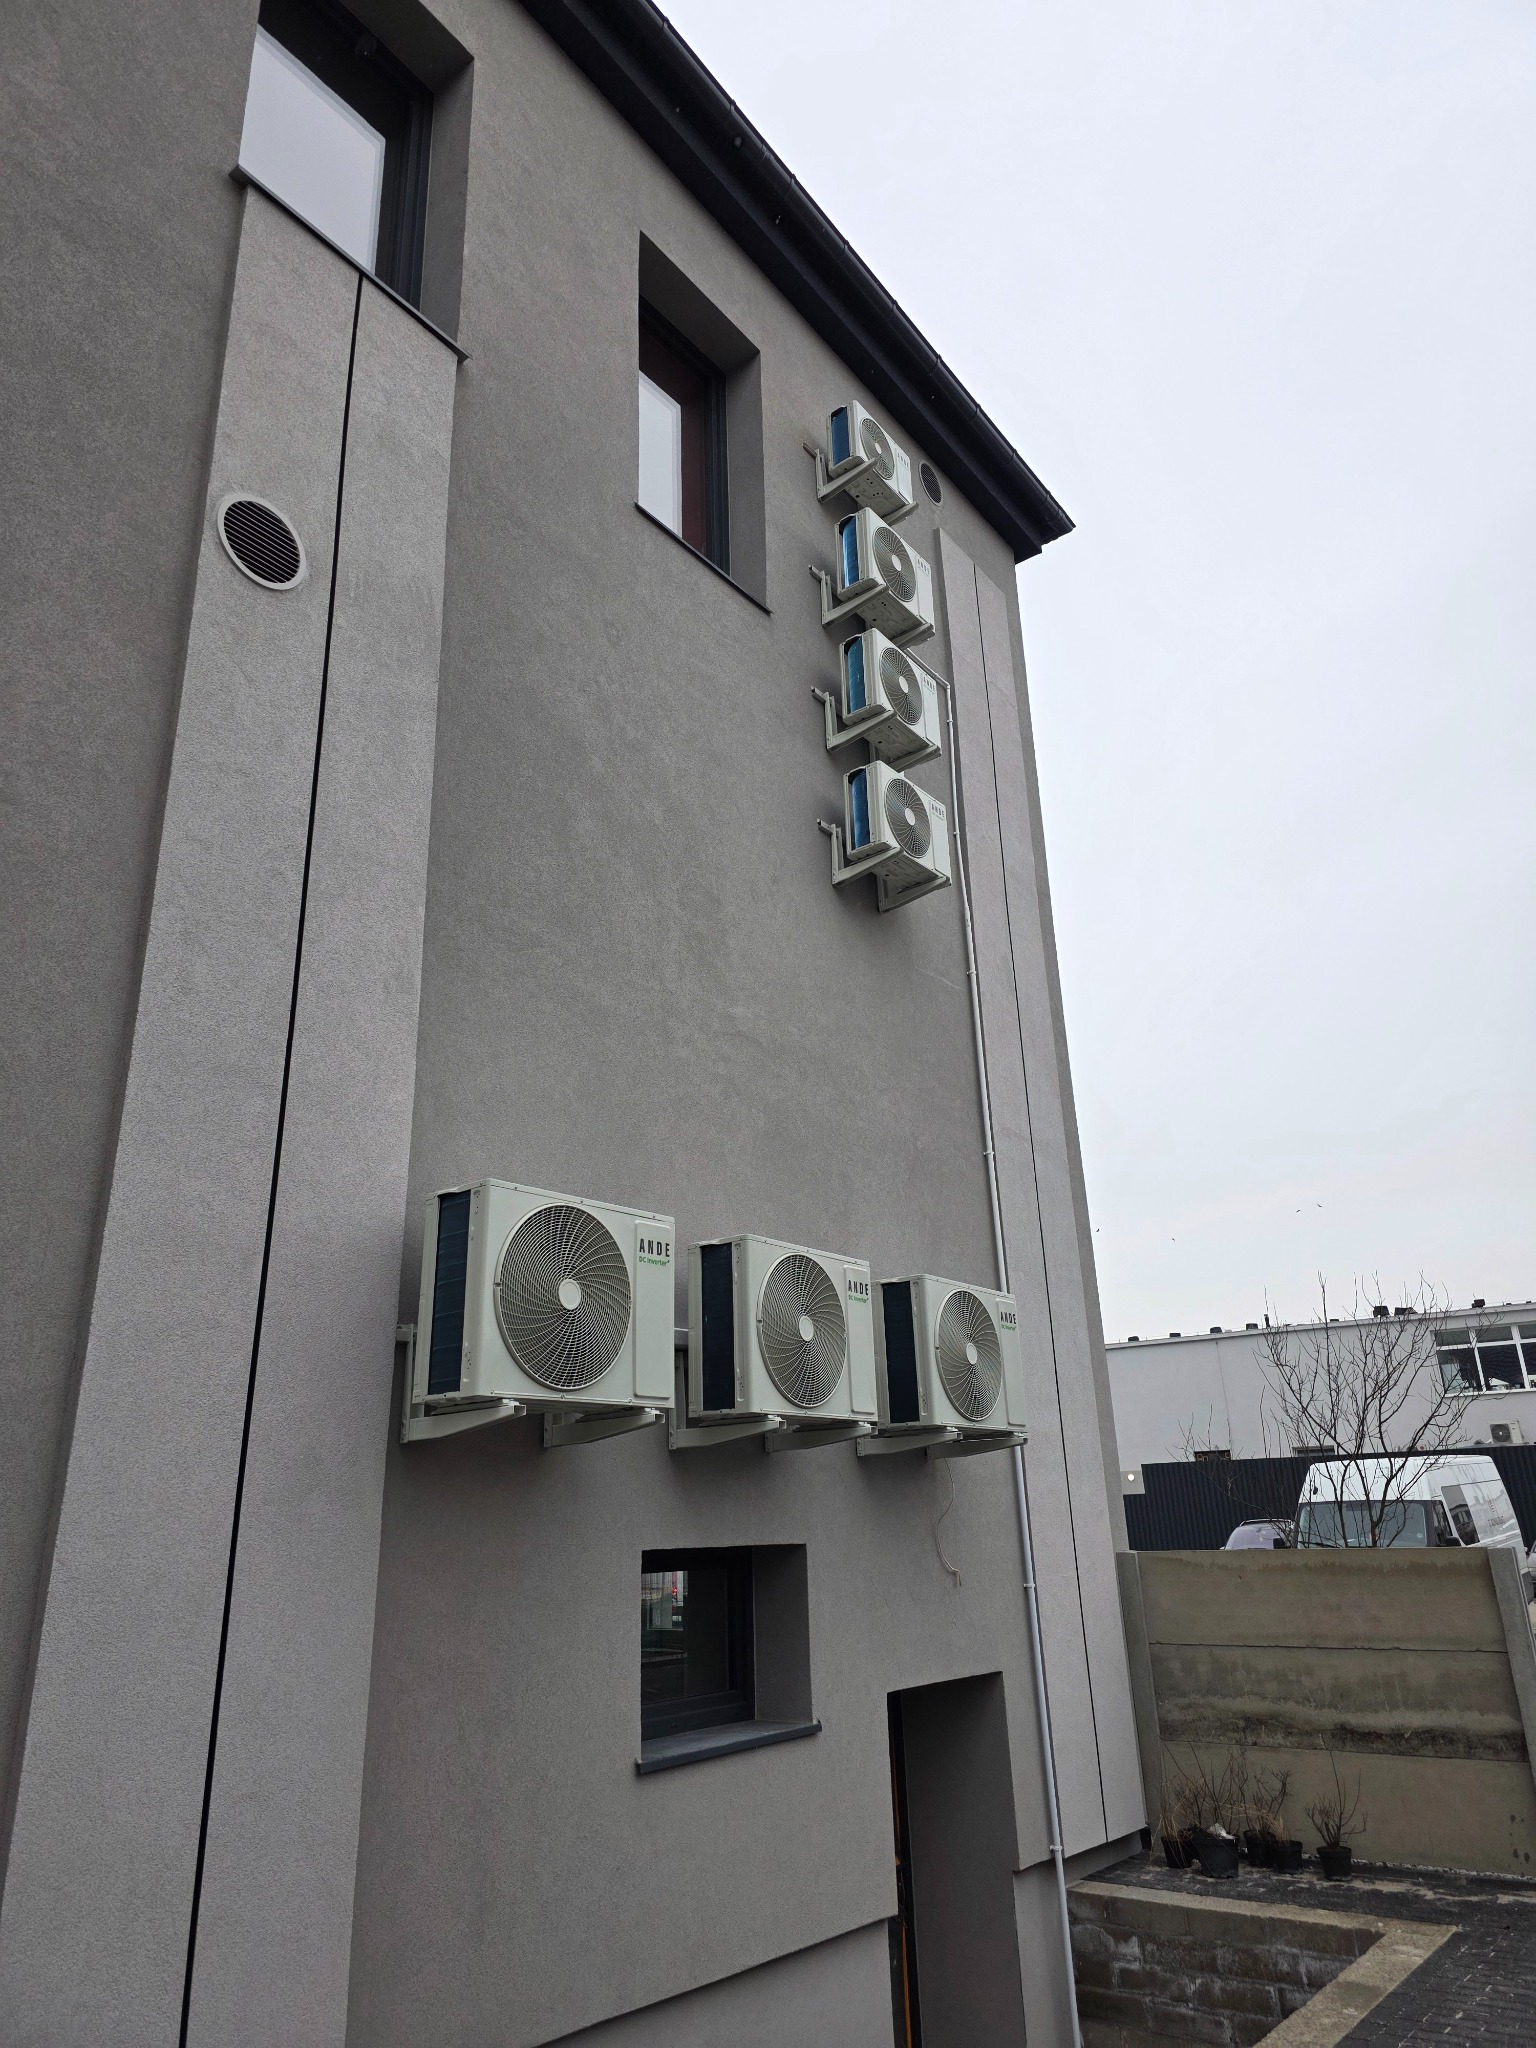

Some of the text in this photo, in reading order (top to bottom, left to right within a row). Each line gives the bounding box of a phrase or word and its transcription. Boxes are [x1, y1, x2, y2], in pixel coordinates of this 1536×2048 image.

[639, 1238, 670, 1257] ANDE
[848, 1280, 869, 1295] ANDE
[1001, 1311, 1017, 1324] ANDE
